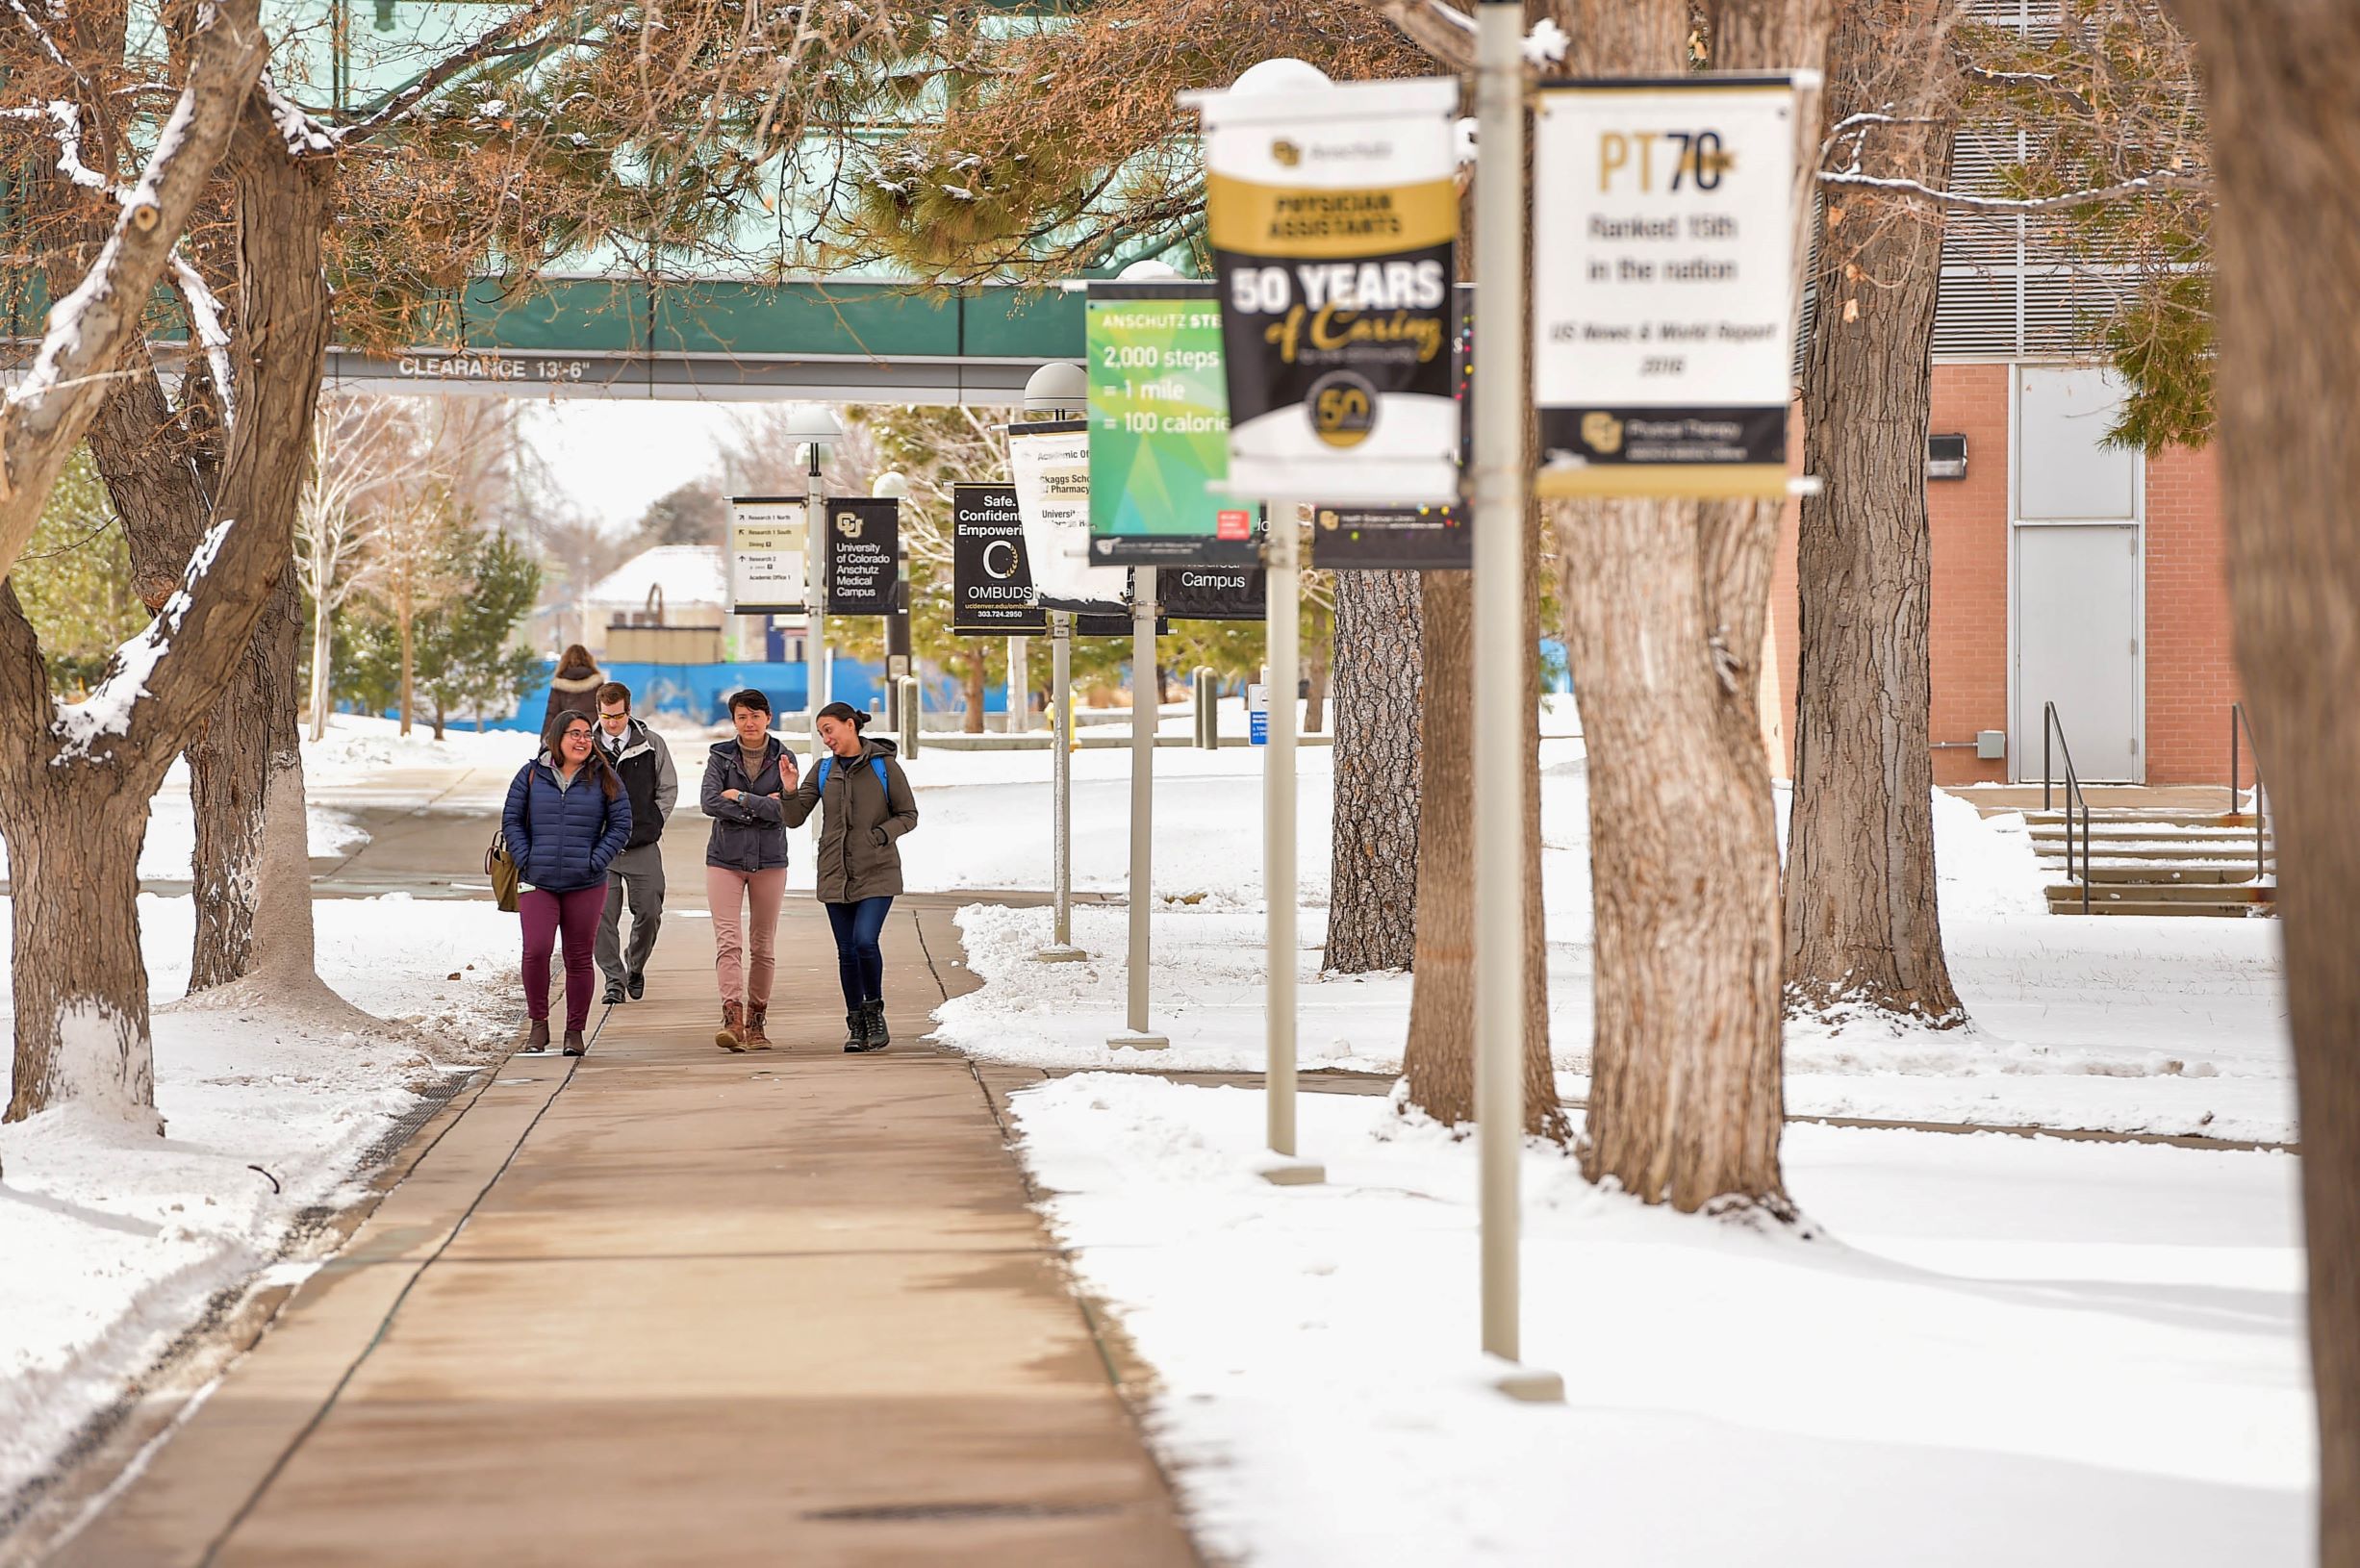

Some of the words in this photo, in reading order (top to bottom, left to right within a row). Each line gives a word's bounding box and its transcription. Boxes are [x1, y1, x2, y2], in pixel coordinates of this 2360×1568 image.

[1618, 258, 1655, 280] the
[1664, 258, 1738, 280] nation
[1231, 266, 1290, 314] 50
[1298, 261, 1445, 312] YEARS
[1103, 314, 1186, 328] ANSCHUTZ
[1190, 314, 1223, 328] STE
[1265, 305, 1306, 363] of
[1310, 302, 1442, 363] Caring
[1104, 346, 1157, 369] 2,000
[1164, 349, 1220, 371] steps
[398, 358, 526, 377] CLEARANCE
[1125, 379, 1131, 399] 1
[1140, 379, 1185, 400] mile
[1125, 412, 1157, 433] 100
[1162, 411, 1231, 433] calorie
[1051, 485, 1090, 494] Pharmacy
[983, 495, 1016, 507] Safe.
[958, 524, 1023, 539] Empoweri
[836, 543, 880, 554] University
[836, 554, 846, 564] of
[848, 554, 890, 564] Colorado
[836, 565, 879, 574] Anschutz
[836, 575, 873, 586] Medical
[1181, 571, 1246, 590] Campus
[836, 587, 876, 598] Campus
[968, 586, 1032, 598] OMBUDS
